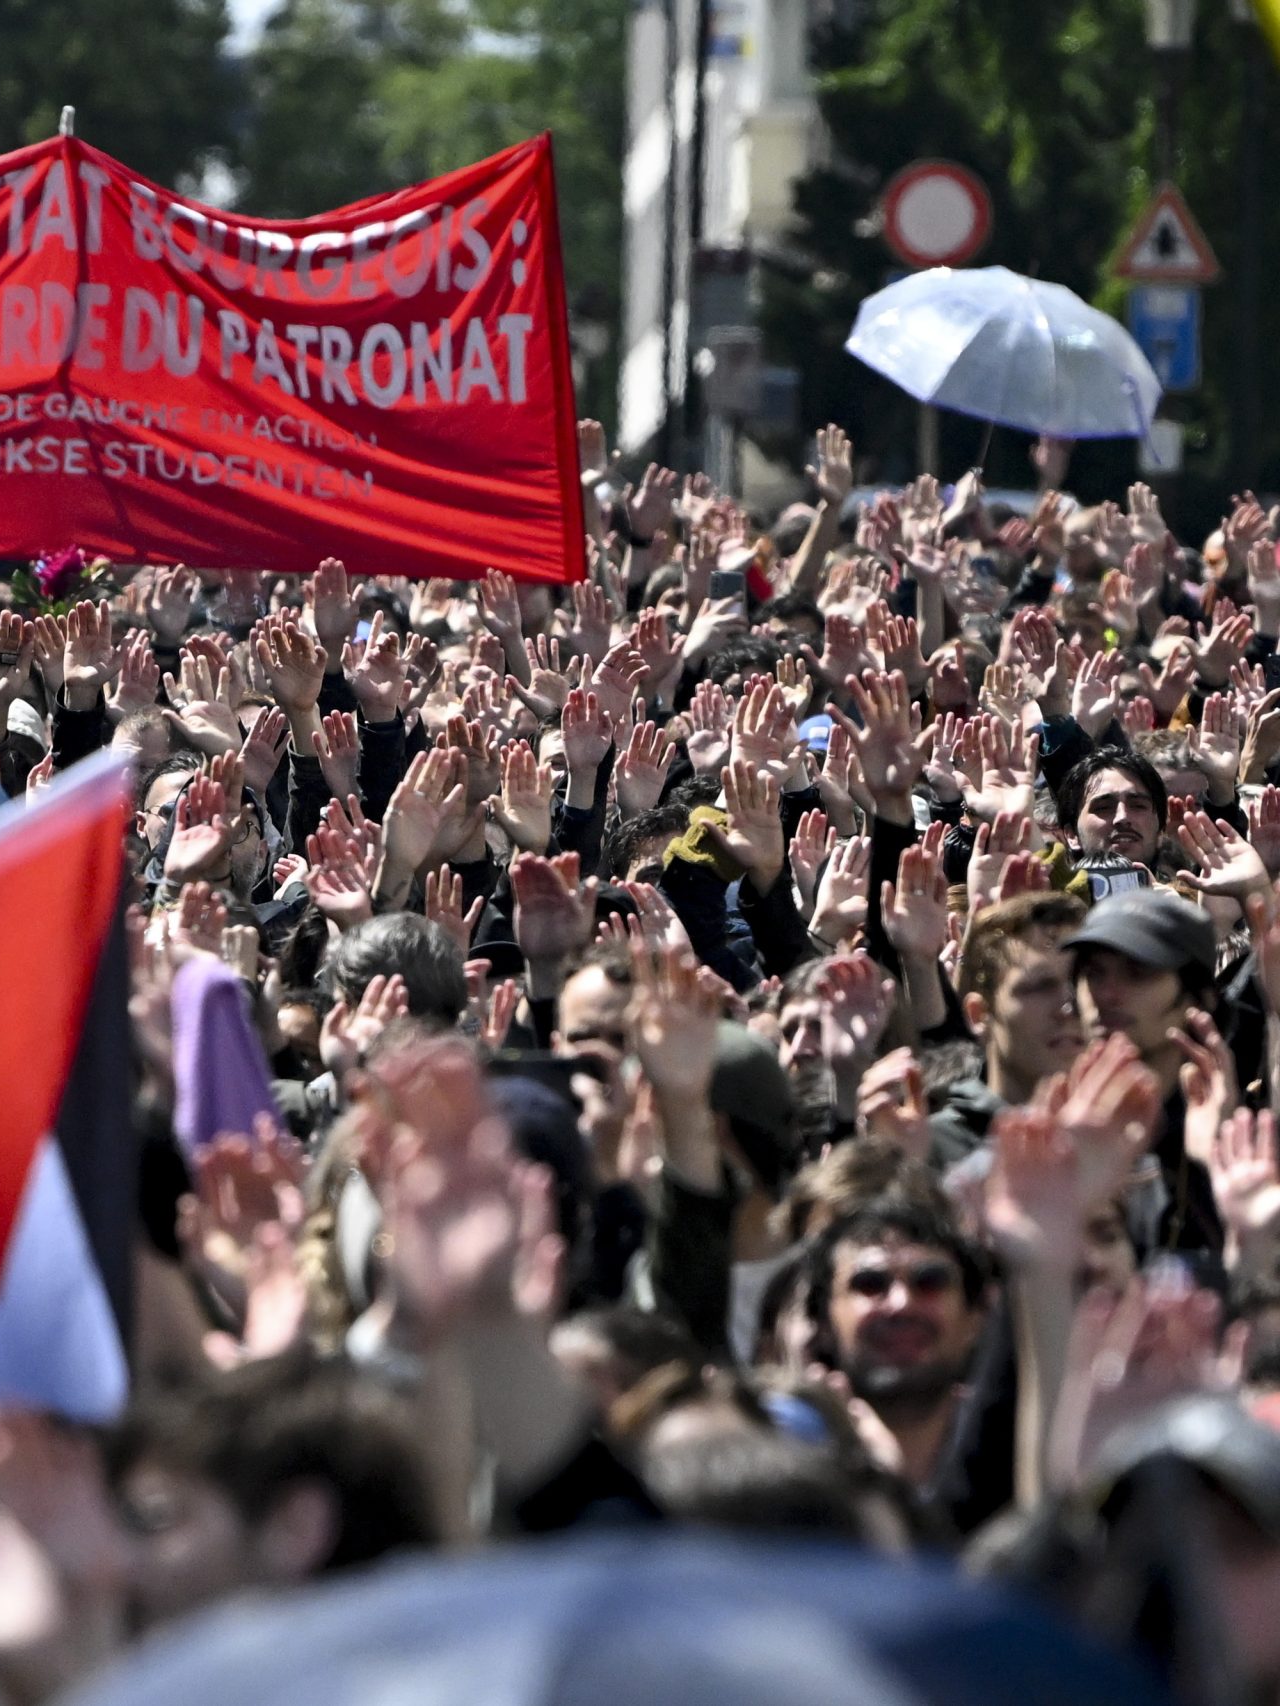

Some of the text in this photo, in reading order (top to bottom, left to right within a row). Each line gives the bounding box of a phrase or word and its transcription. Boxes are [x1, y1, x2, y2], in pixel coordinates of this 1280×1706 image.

[121, 287, 205, 378] DU
[217, 309, 534, 410] PATRONAT
[44, 392, 187, 431] GAUCHE
[200, 407, 245, 436] EN
[251, 415, 378, 452] ACTION
[103, 440, 374, 499] STUDENTEN
